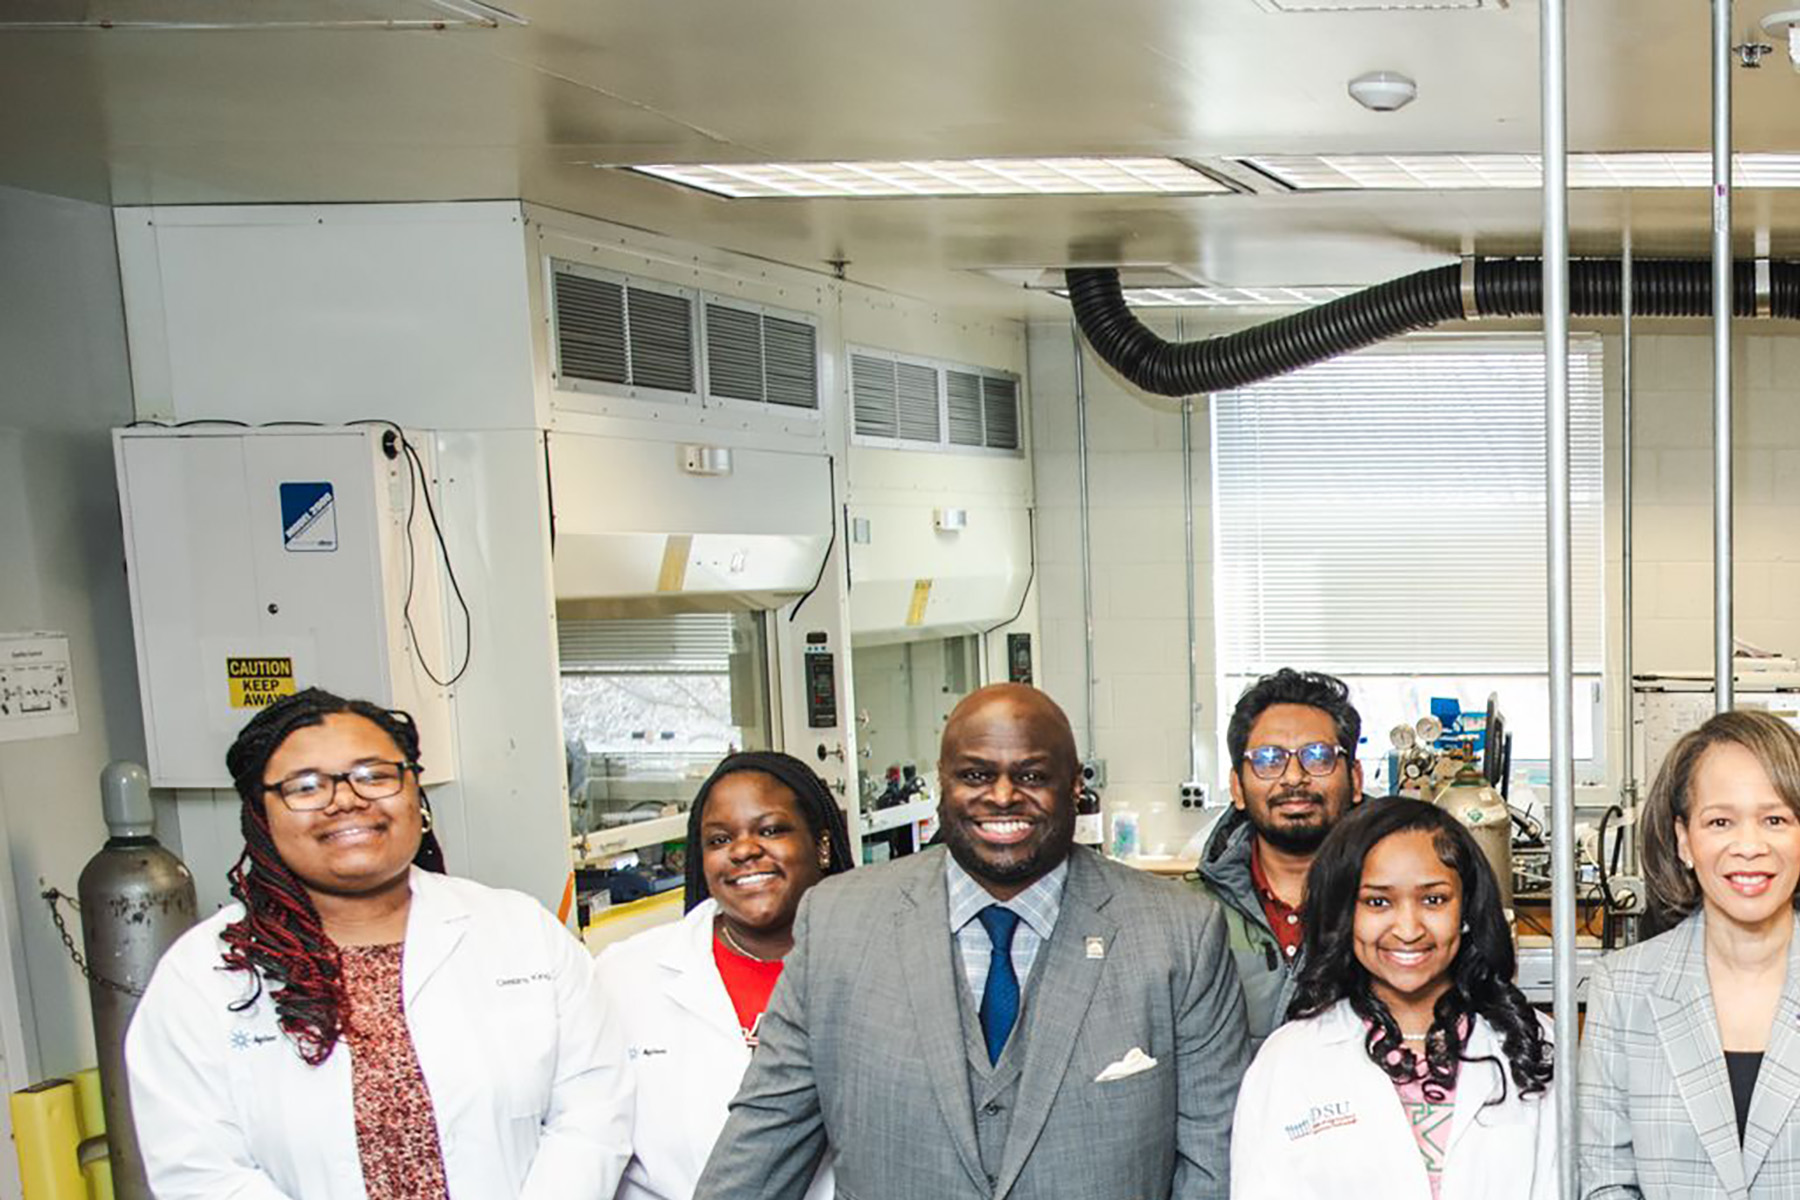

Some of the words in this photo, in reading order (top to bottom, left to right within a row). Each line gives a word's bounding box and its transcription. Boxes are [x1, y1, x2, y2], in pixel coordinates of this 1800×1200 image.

[230, 660, 290, 676] CAUTION
[242, 679, 280, 692] KEEP
[1310, 1100, 1350, 1122] DSU
